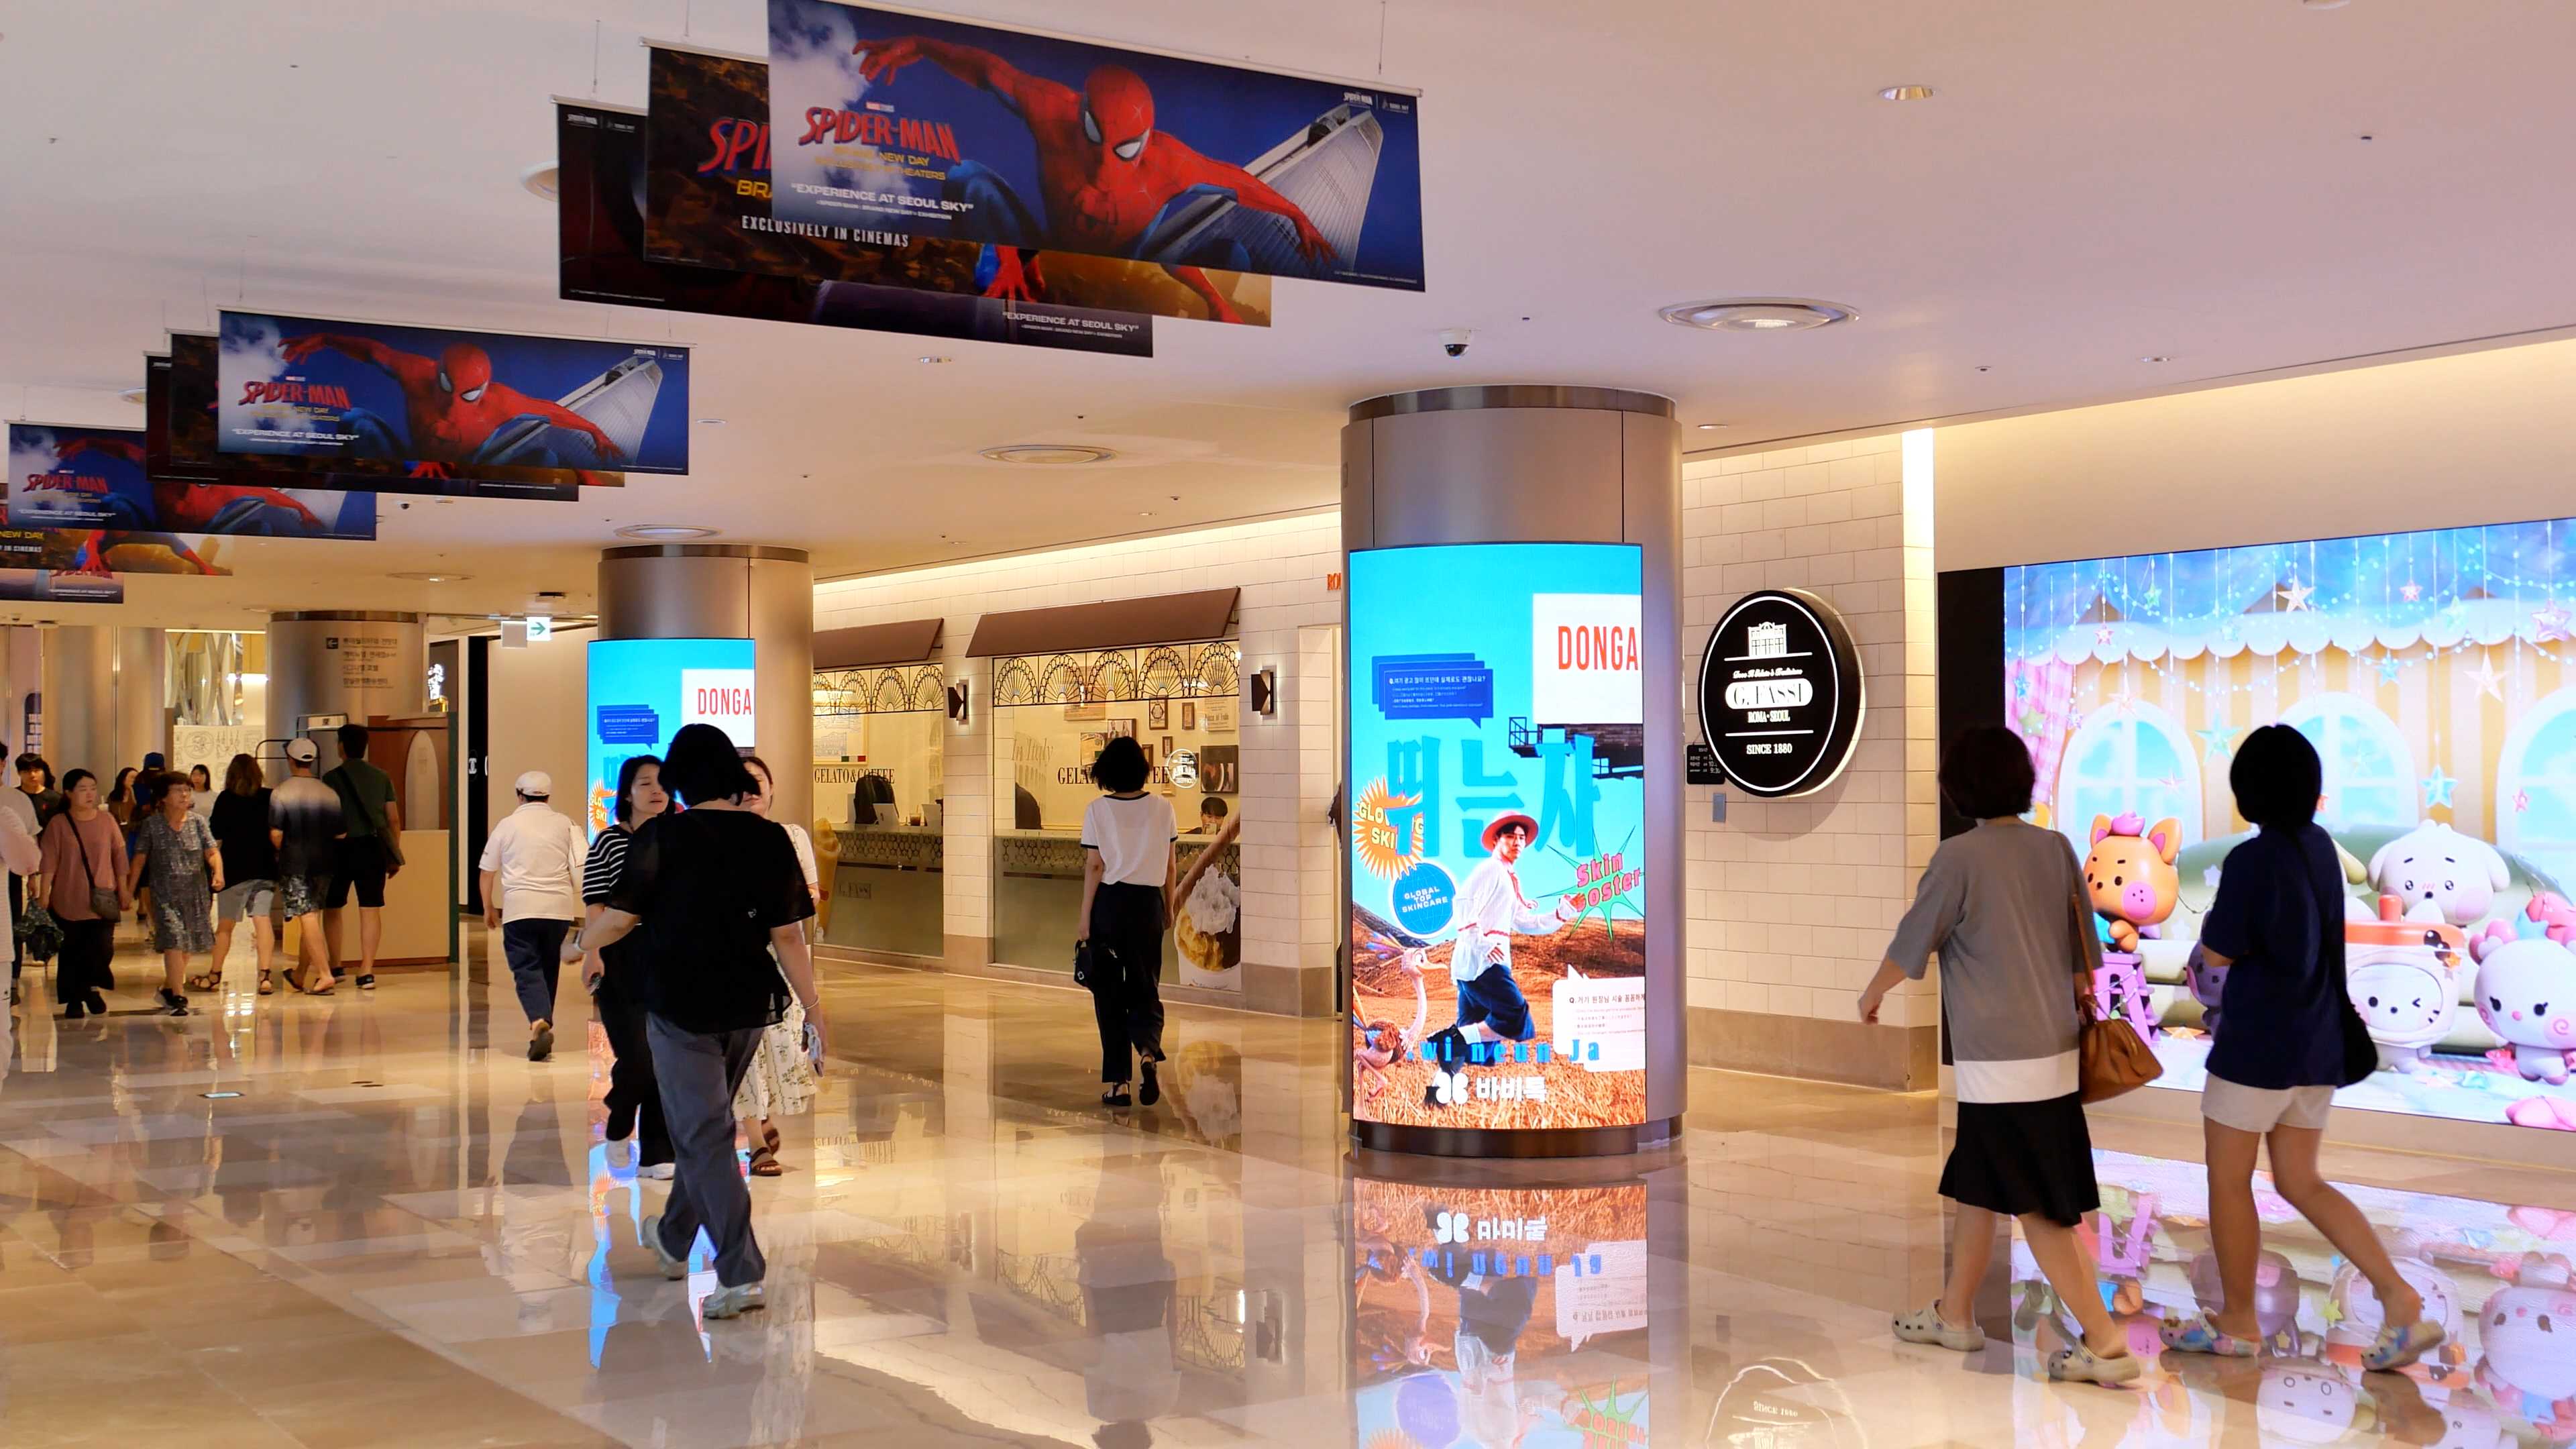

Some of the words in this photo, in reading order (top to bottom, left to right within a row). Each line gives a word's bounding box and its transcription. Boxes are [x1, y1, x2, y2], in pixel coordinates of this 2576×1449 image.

[798, 106, 961, 165] SPIDER-MAN
[908, 154, 930, 166] DAY
[878, 193, 896, 204] AT
[898, 195, 939, 209] SEOUL
[741, 215, 828, 239] EXCLUSIVELY
[834, 227, 848, 241] IN
[853, 228, 909, 248] CINEMAS
[1068, 319, 1081, 327] AT
[1081, 319, 1113, 331] SEOUL
[238, 381, 352, 412] SPIDER-MAN
[22, 474, 110, 494] SPIDER-MAN
[1558, 626, 1639, 670] DONGA
[698, 688, 752, 715] DONGA
[1746, 744, 1772, 755] SINCE
[1773, 743, 1793, 754] 1880
[1576, 853, 1623, 888] Skin
[1404, 885, 1440, 900] GLOBAL
[1413, 894, 1432, 904] TOP
[1401, 896, 1448, 913] SKINCARE
[1471, 1042, 1551, 1064] neun
[1570, 1038, 1601, 1063] Ja
